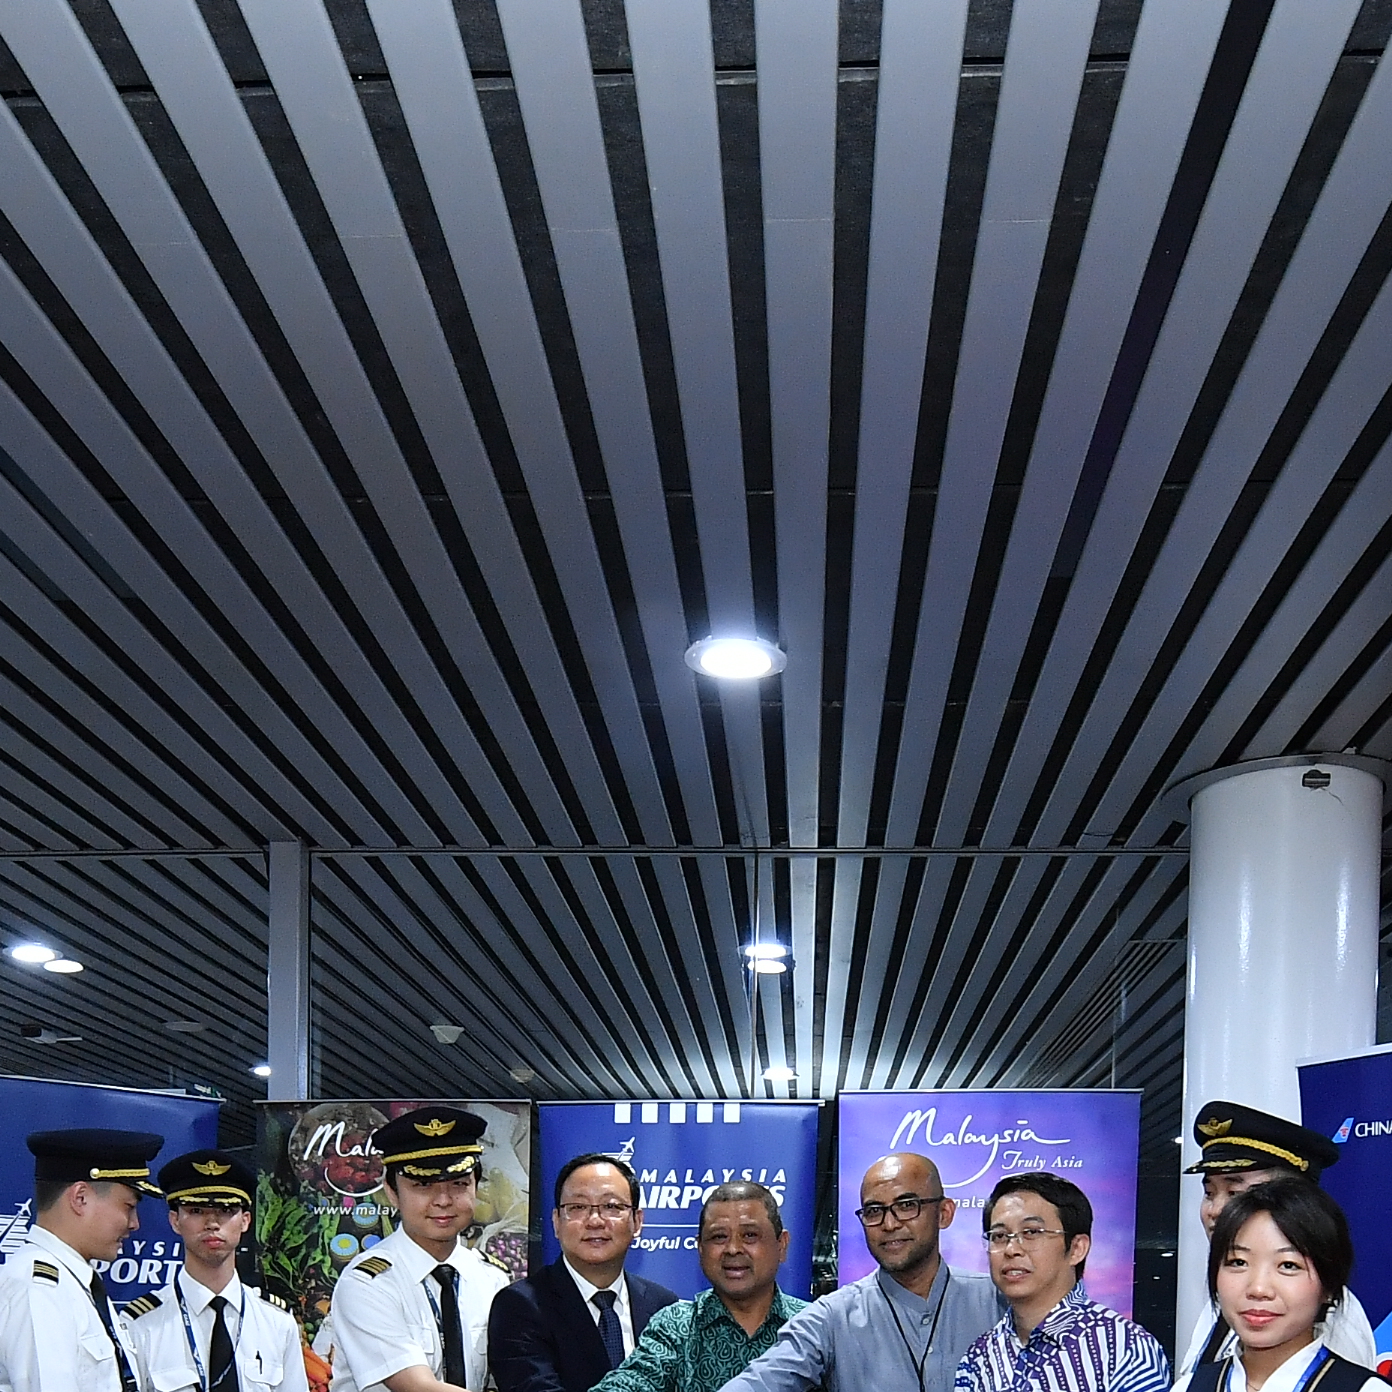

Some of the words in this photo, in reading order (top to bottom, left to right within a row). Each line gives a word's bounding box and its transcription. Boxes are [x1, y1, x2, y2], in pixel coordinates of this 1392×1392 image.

[889, 1107, 1071, 1188] Malaysia
[1001, 1151, 1046, 1171] Truly
[1051, 1157, 1083, 1168] Asia
[640, 1168, 786, 1183] MALAYSIA
[637, 1185, 786, 1209] AIRPS
[313, 1204, 398, 1216] www.malay
[631, 1236, 680, 1250] Joyful
[89, 1257, 183, 1284] PORT
